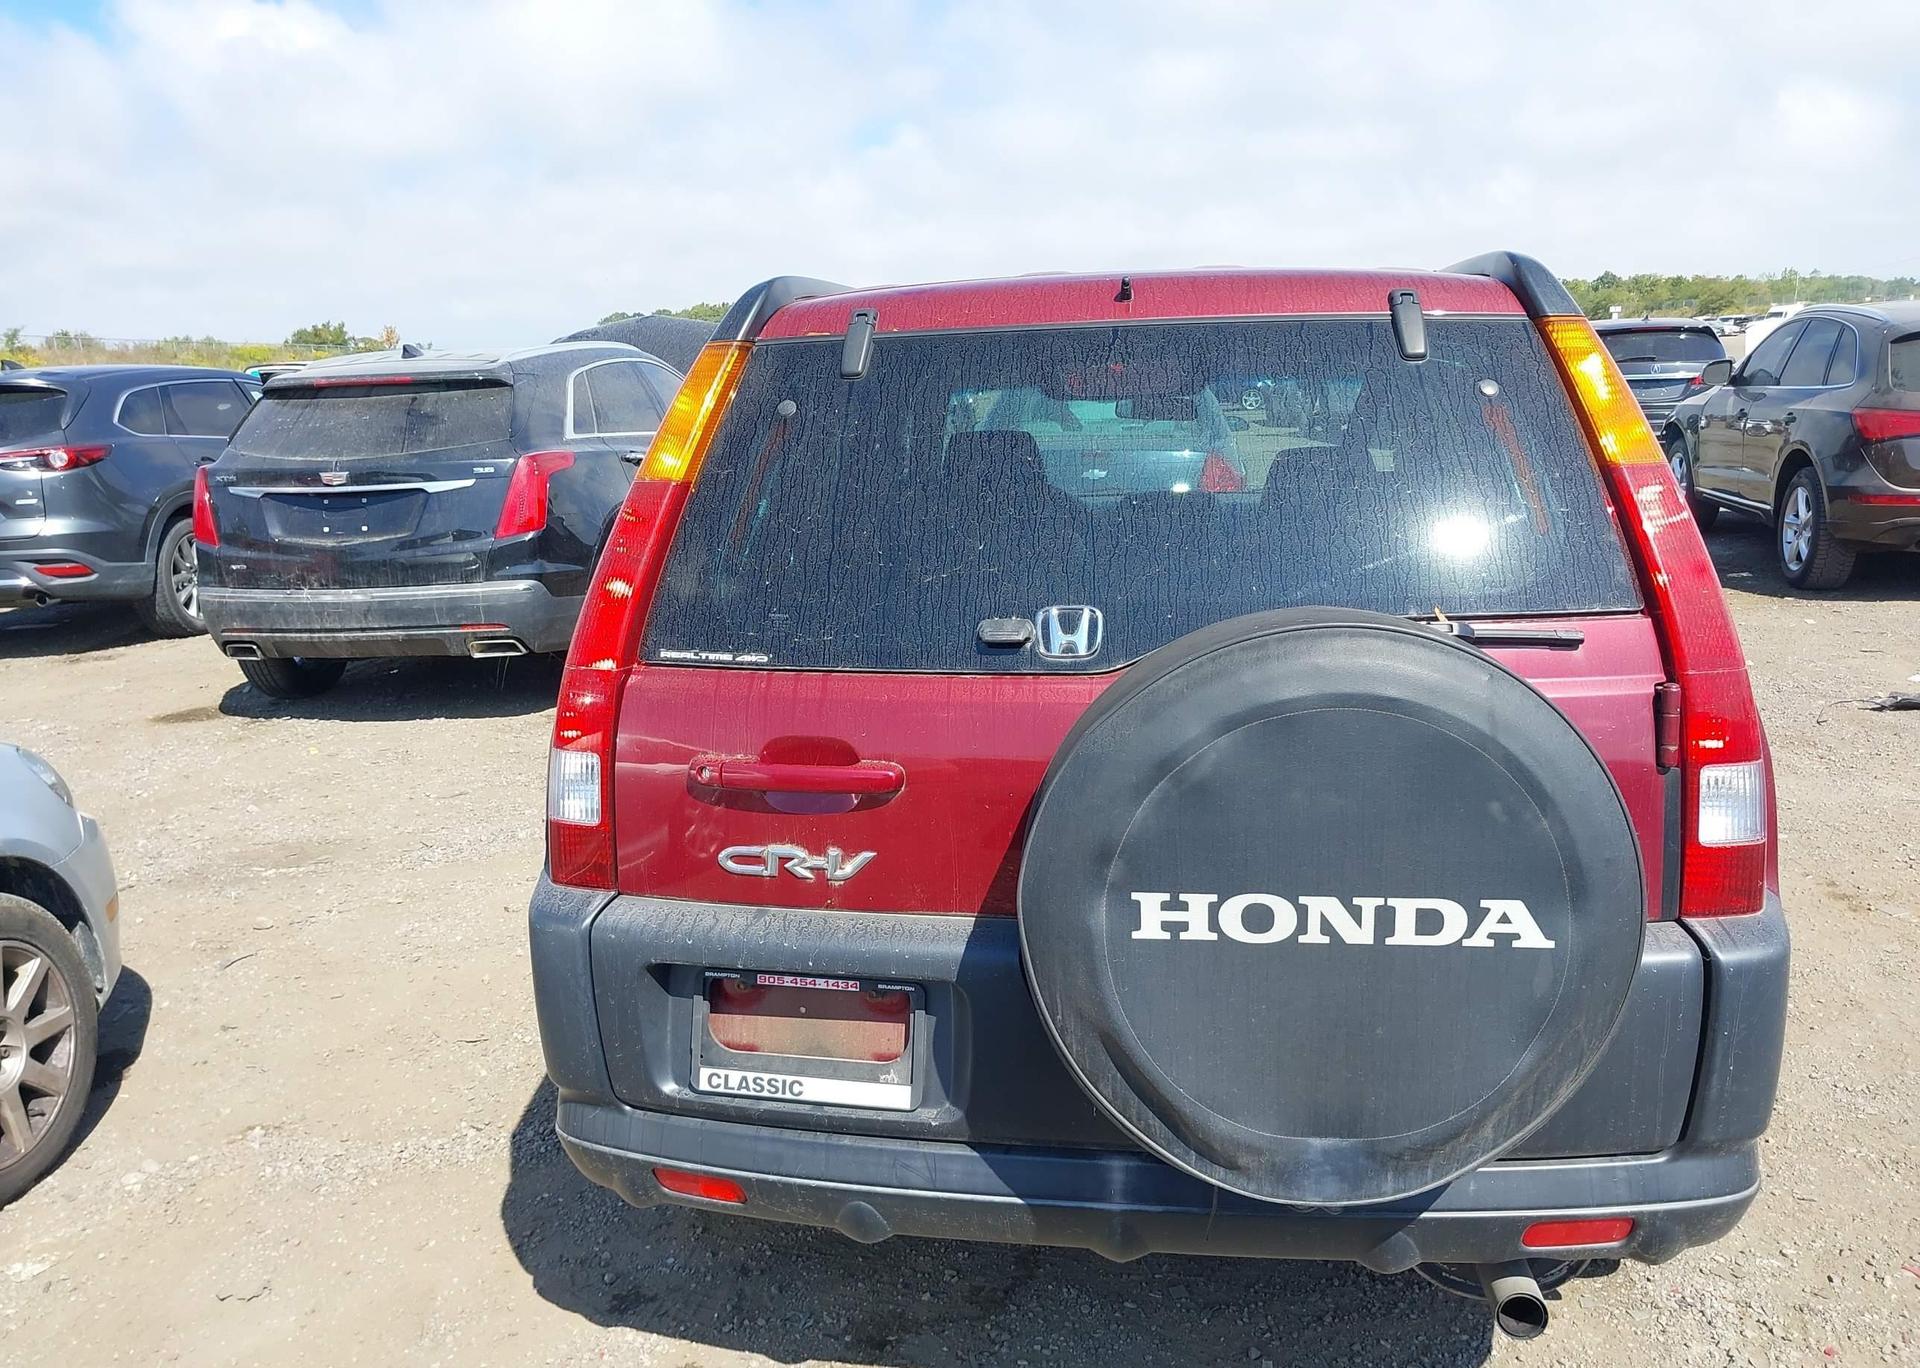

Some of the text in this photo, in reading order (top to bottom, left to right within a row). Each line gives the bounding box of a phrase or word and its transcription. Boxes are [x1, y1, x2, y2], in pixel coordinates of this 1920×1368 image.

[735, 654, 769, 662] 4WD
[717, 845, 877, 881] CR-V
[1131, 891, 1556, 949] HONDA
[704, 971, 741, 979] BRAMPTON
[877, 983, 915, 992] BRAMPTON
[707, 1072, 804, 1097] CLASSIC
